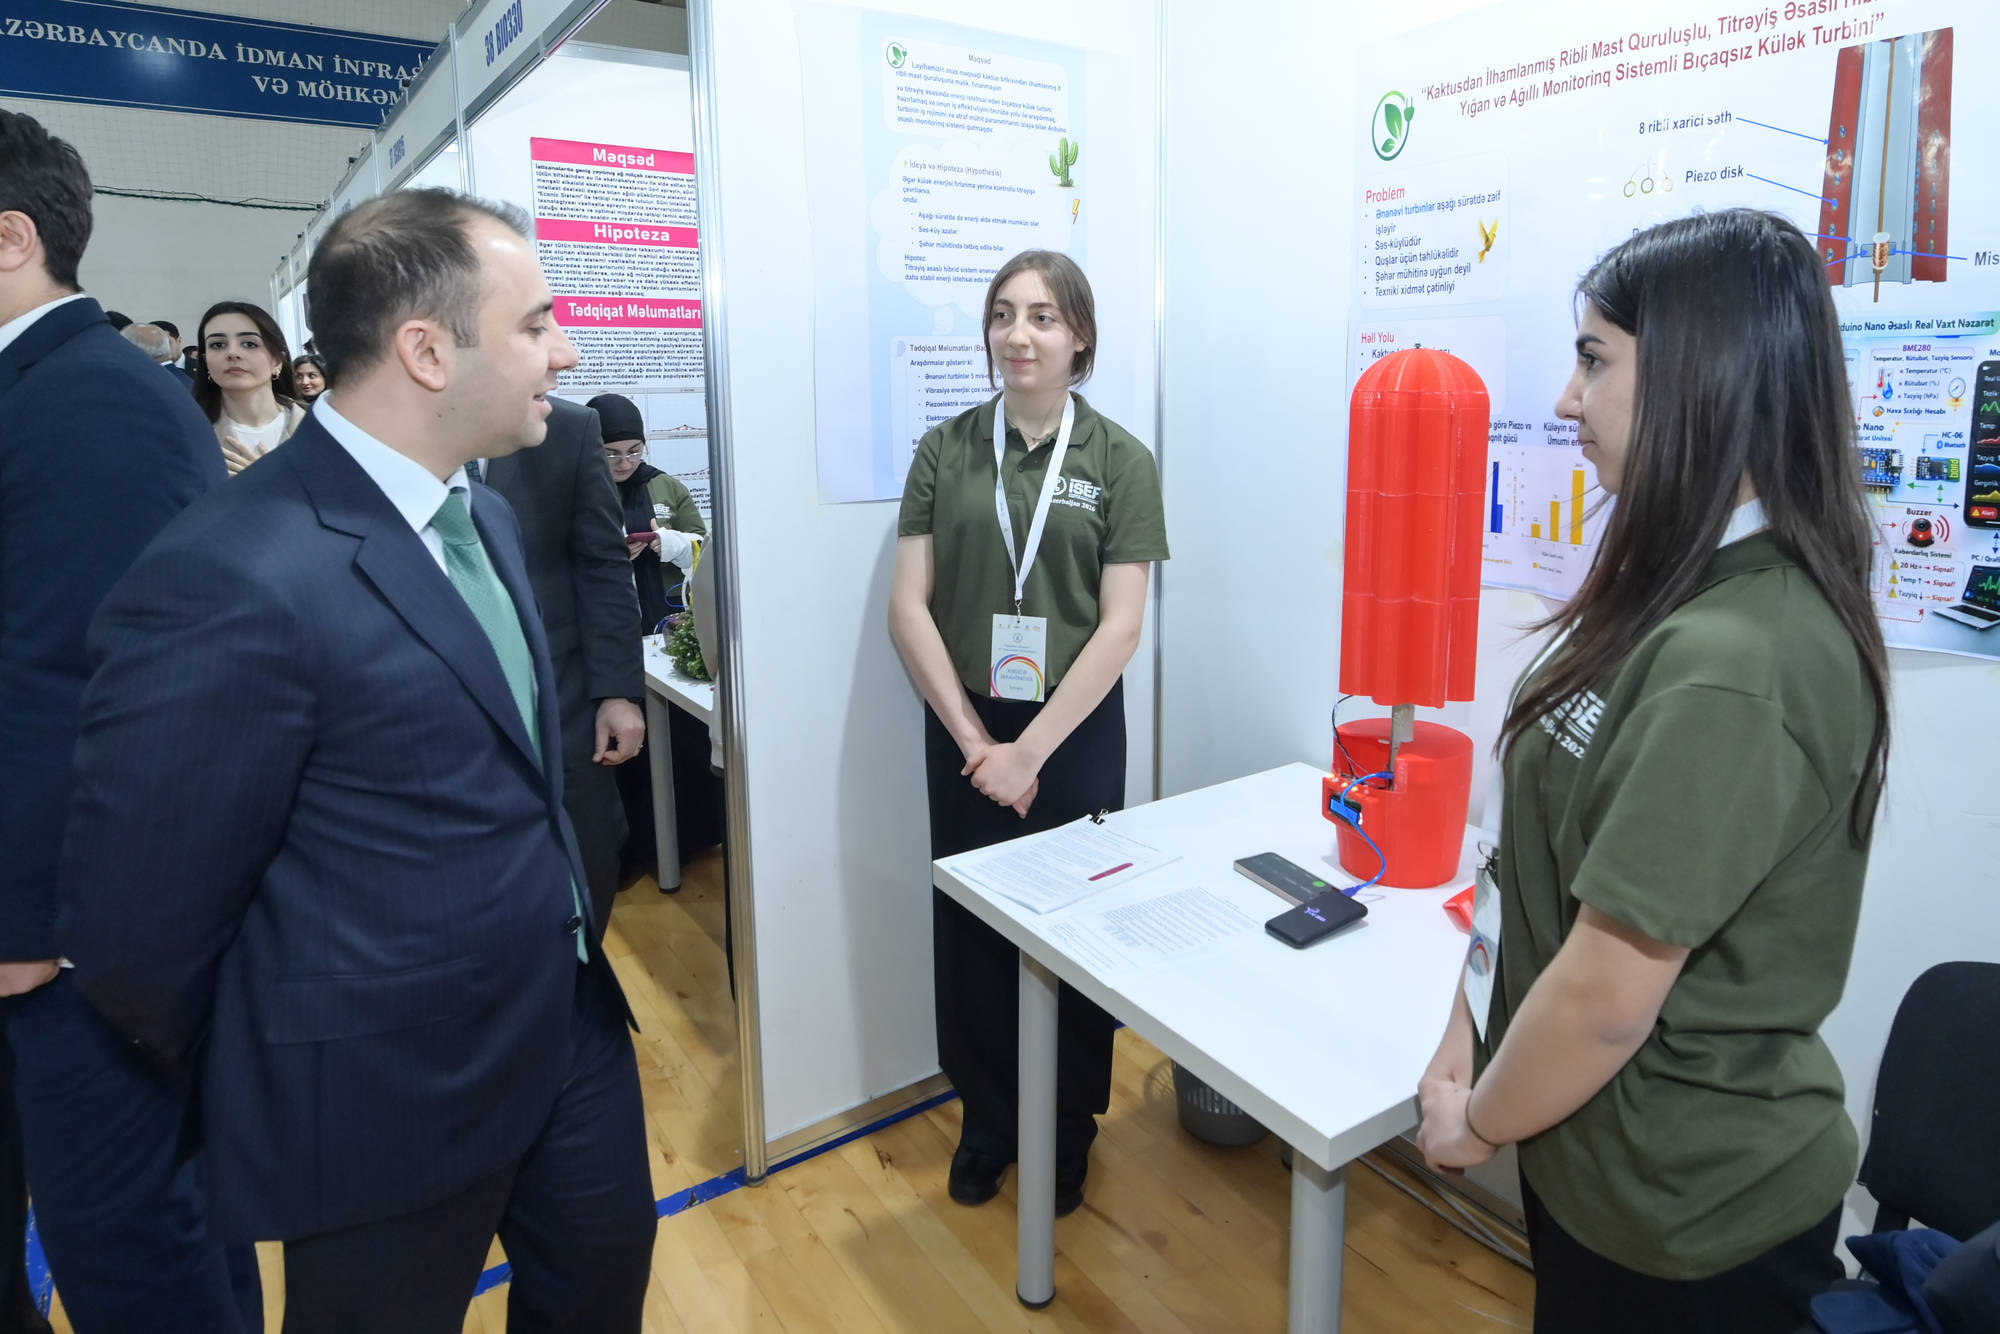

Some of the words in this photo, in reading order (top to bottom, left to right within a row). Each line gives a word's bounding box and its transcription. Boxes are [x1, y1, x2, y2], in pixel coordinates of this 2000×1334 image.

[485, 30, 494, 66] 38
[1486, 57, 1555, 86] İlhamlanmış
[1560, 45, 1588, 68] Ribli
[1591, 37, 1623, 60] Mast
[1628, 23, 1711, 51] Quruluşlu,
[1718, 7, 1778, 37] Titrəyiş
[236, 43, 323, 71] İDMAN
[1460, 97, 1490, 118] Yığan
[1494, 95, 1506, 107] və
[1509, 84, 1539, 107] Ağıllı
[1543, 68, 1611, 98] Monitorinq
[1616, 55, 1677, 81] Sistemli
[1683, 45, 1753, 72] Bıçaqsız
[1759, 31, 1806, 57] Külək
[251, 76, 288, 94] VƏ
[1639, 122, 1645, 134] 8
[1673, 114, 1704, 130] xarici
[1707, 110, 1732, 125] səth
[593, 148, 654, 167] Məqsəd
[1686, 170, 1717, 183] Piezo
[1720, 165, 1744, 180] disk
[1366, 187, 1405, 204] Problem
[1376, 207, 1403, 219] Ənənəvi
[1405, 202, 1435, 215] turbinlər
[1458, 195, 1485, 207] sürətdə
[1487, 190, 1500, 202] zəif
[594, 224, 670, 242] Hipoteza
[1375, 236, 1421, 251] Səs-küylüdür
[1375, 254, 1398, 267] Quşlar
[1400, 252, 1418, 263] üçün
[1419, 248, 1459, 262] təhlükəlidir
[1375, 271, 1395, 283] Şəhər
[1397, 266, 1428, 280] mühitinə
[1430, 265, 1452, 278] uyğun
[1454, 262, 1471, 276] deyil
[1375, 285, 1399, 296] Texniki
[1401, 283, 1425, 295] xidmət
[1426, 280, 1455, 295] çətinliyi
[568, 302, 623, 321] Tədqiqat
[628, 304, 702, 319] Məlumatları
[1864, 321, 1885, 331] Nano
[1888, 320, 1912, 330] Əsaslı
[1915, 319, 1933, 329] Real
[1936, 319, 1955, 329] Vaxt
[1958, 318, 1995, 328] Nəzarət
[1378, 332, 1394, 343] Yolu
[1508, 421, 1524, 430] Piezo
[1543, 422, 1567, 432] Küləyin
[1863, 423, 1884, 431] Nano
[1503, 434, 1518, 443] gücü
[1547, 435, 1569, 446] Ümumi
[1906, 508, 1932, 516] Buzzer
